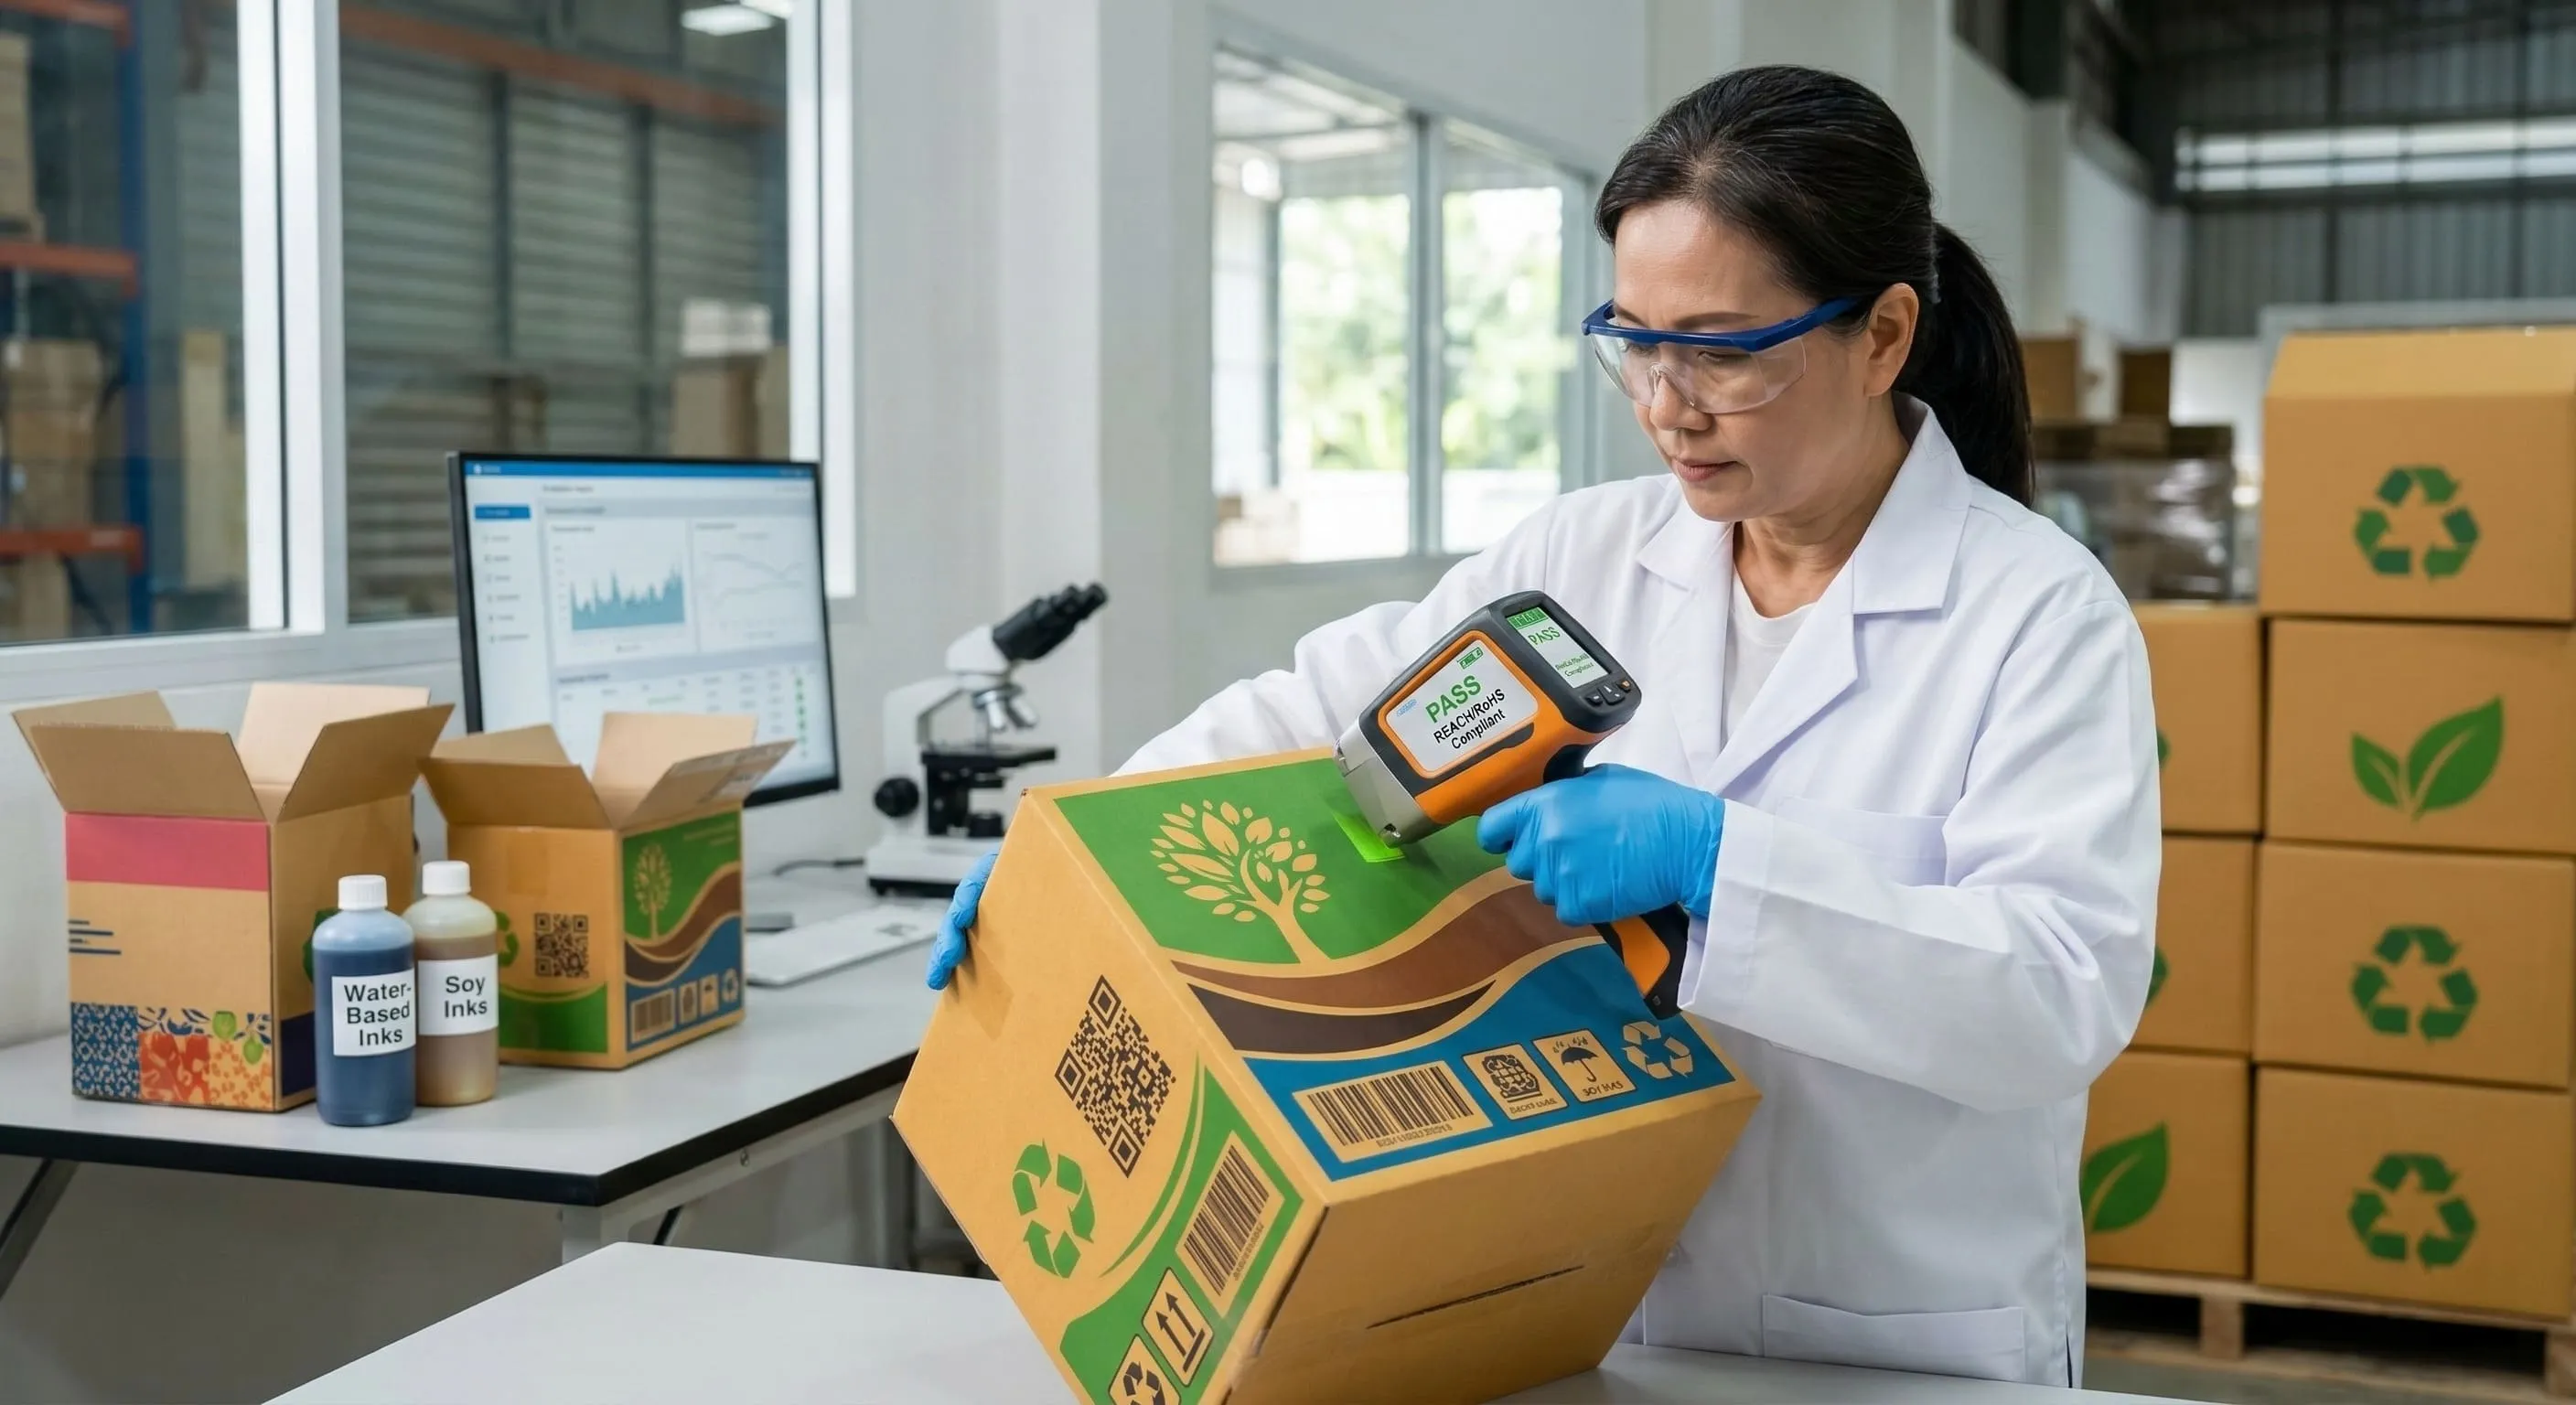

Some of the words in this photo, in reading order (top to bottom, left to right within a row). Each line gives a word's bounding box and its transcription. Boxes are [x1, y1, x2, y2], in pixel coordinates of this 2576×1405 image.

[1528, 627, 1561, 646] PASS
[1425, 675, 1482, 724] PASS
[1433, 689, 1505, 744] REACH/RoHS
[344, 982, 412, 1003] Water-
[445, 976, 486, 996] Soy
[347, 1001, 411, 1024] Based
[445, 999, 488, 1018] Inks
[359, 1027, 403, 1046] Inks
